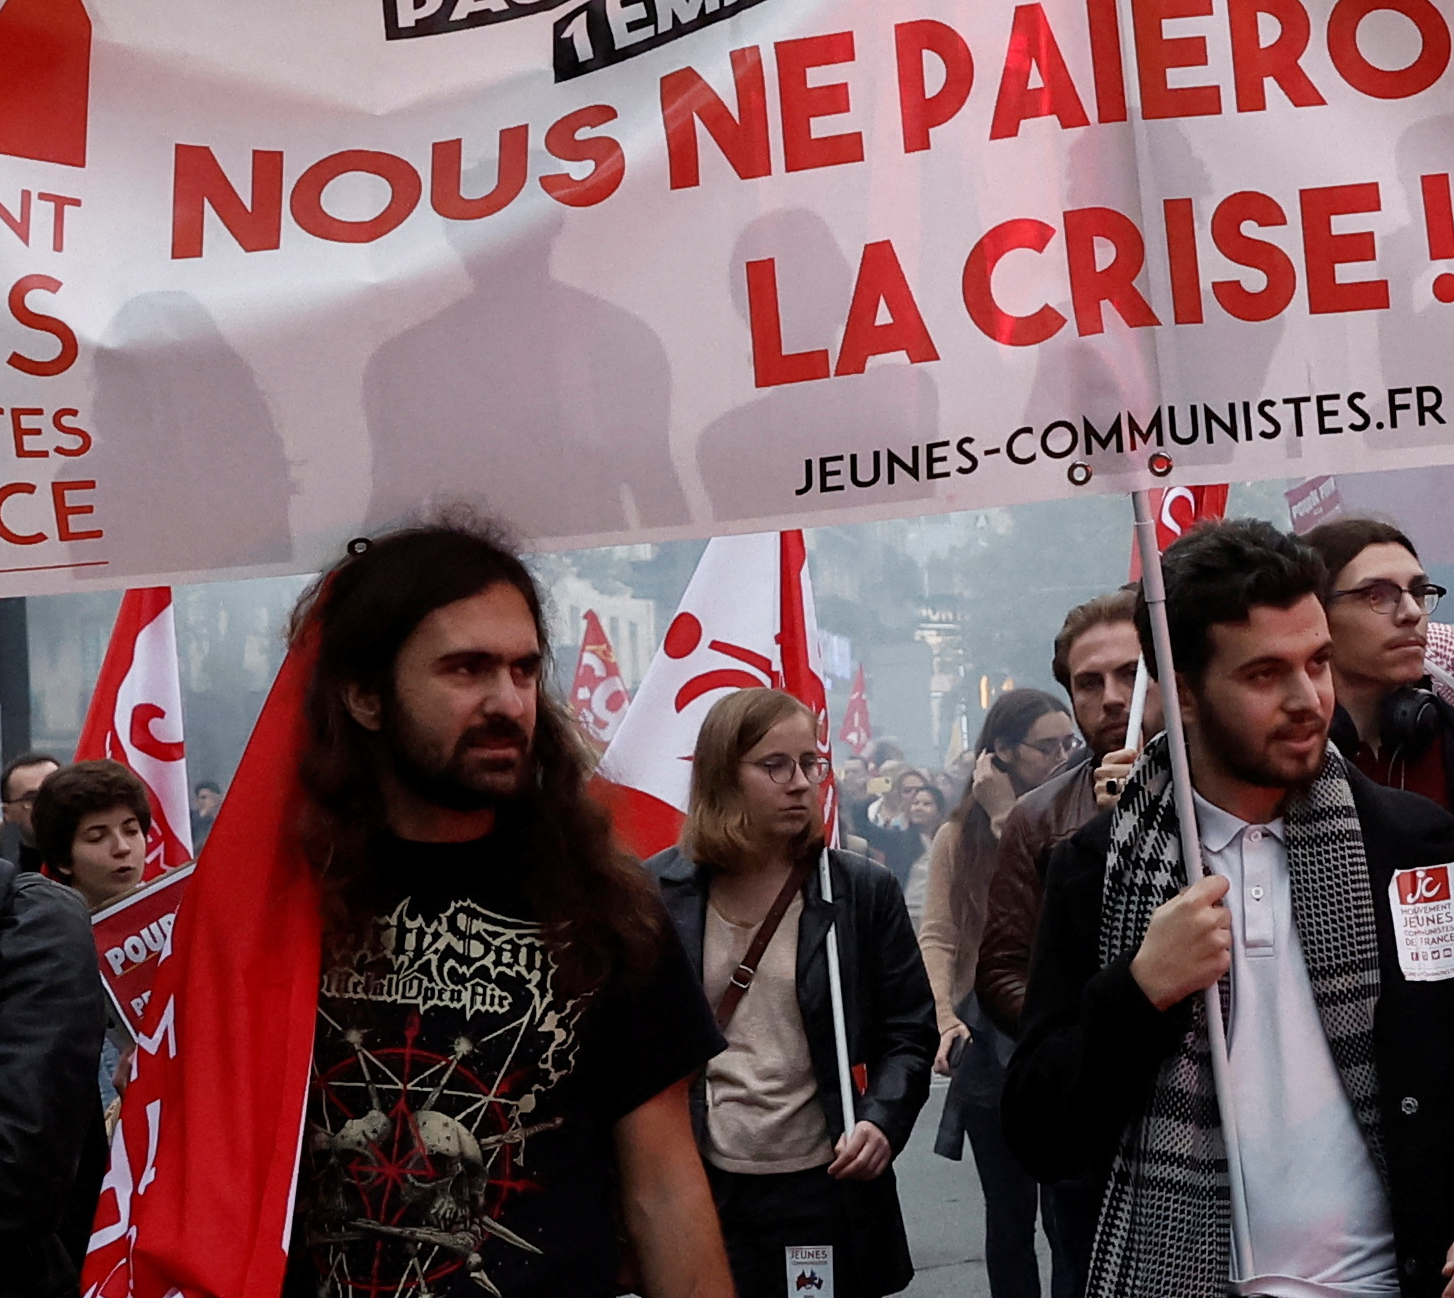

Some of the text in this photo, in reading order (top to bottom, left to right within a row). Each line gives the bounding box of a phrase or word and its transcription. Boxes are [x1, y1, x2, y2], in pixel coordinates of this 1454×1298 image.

[559, 12, 593, 64] 1
[171, 104, 626, 260] NOUS
[659, 30, 865, 191] NE
[746, 240, 941, 388] LA
[961, 182, 1390, 347] CRISE
[794, 385, 1447, 497] JEUNES-COMMUNISTES.FR
[1401, 903, 1451, 915] MOUVEMENT
[1403, 912, 1453, 928] JEUNES
[791, 1250, 827, 1260] JEUNES
